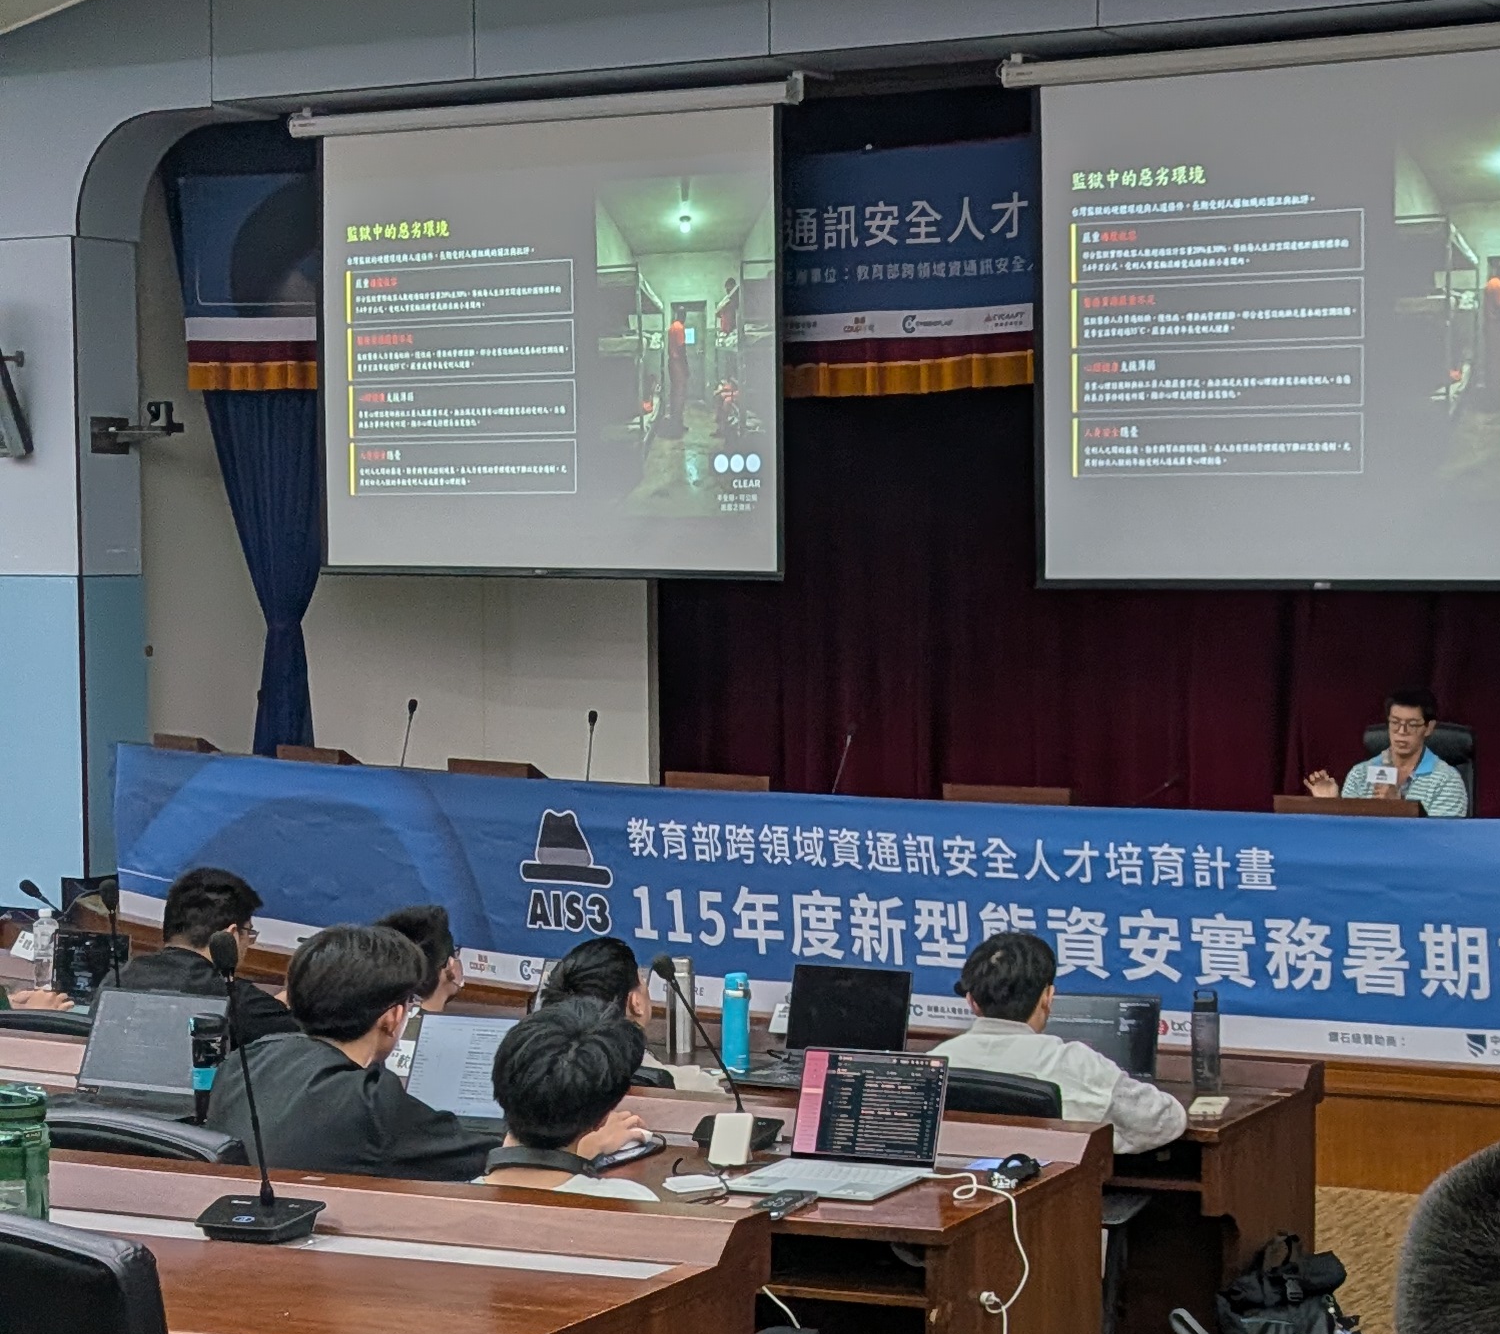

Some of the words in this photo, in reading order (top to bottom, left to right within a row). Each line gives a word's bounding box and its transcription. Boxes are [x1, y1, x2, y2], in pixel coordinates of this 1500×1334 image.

[1071, 164, 1207, 190] 監獄中的惡劣環境
[346, 219, 451, 243] 監獄中的惡劣環境
[785, 191, 1030, 252] 通訊安全人才
[732, 479, 761, 489] CLEAR
[626, 816, 1278, 892] 教育部跨領域資通訊安全人才培育計畫
[526, 889, 613, 936] AIS3
